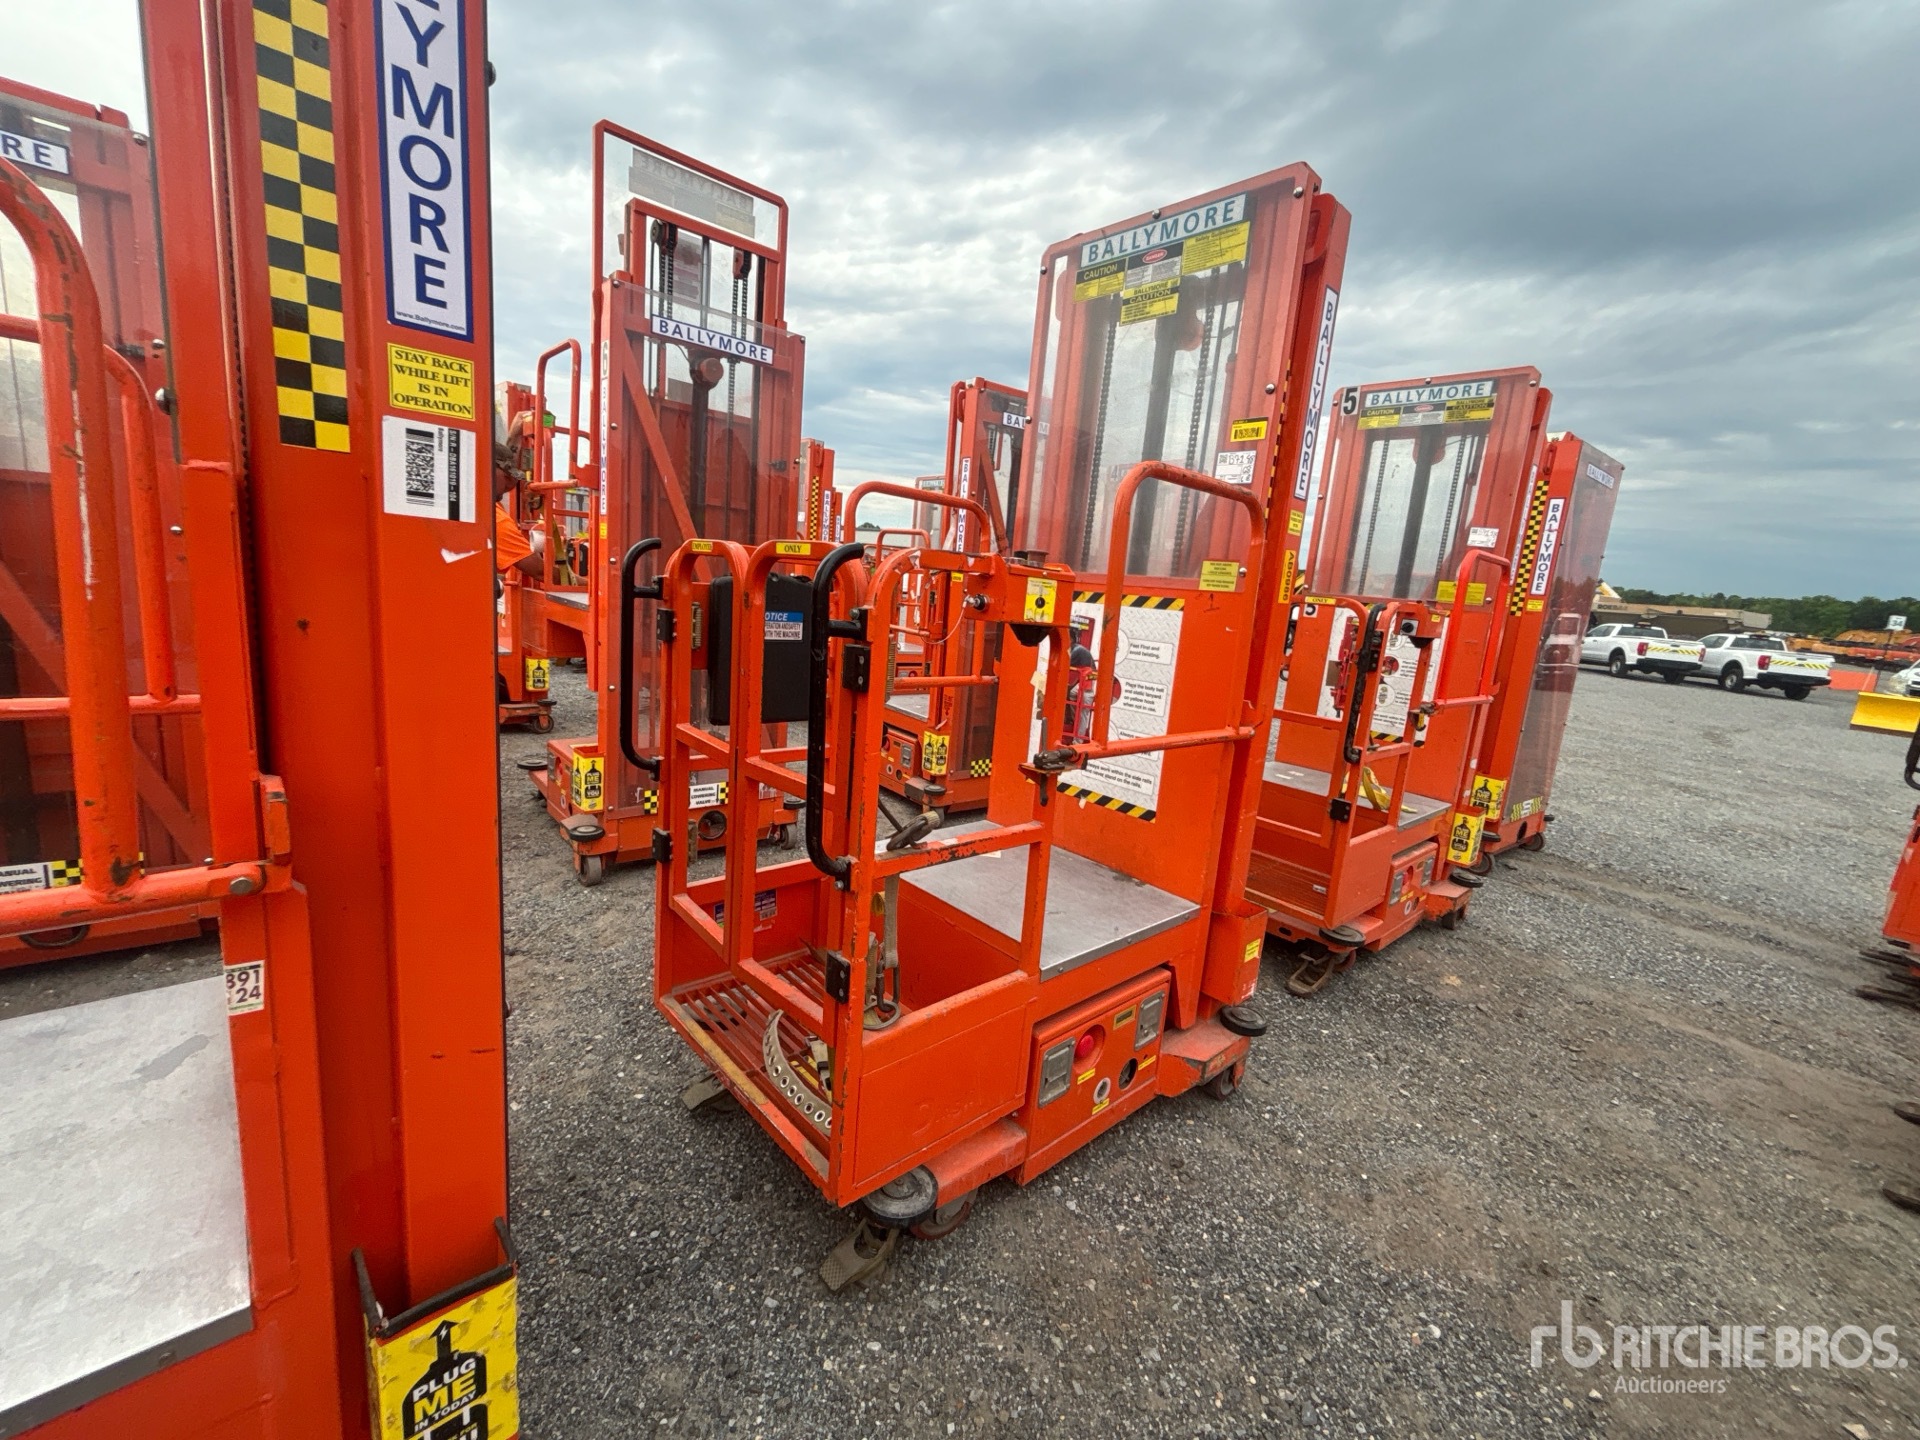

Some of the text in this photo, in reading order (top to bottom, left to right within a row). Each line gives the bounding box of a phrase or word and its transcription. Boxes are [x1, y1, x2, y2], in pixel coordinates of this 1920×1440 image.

[1088, 200, 1236, 263] BALLYMORE
[1083, 263, 1118, 281] CAUTION
[1130, 289, 1172, 304] CAUTION
[1134, 281, 1169, 296] BALLYMORE
[396, 310, 466, 332] www.Ballymore.com
[659, 319, 768, 361] BALLYMORE
[395, 349, 469, 374] STAY BACK
[393, 363, 471, 388] WHILE LIFT
[418, 382, 449, 397] IS IN
[1299, 301, 1333, 491] BALLYMORE
[1370, 383, 1486, 406] BALLYMORE
[393, 393, 472, 415] OPERATION
[1342, 387, 1358, 415] 5
[784, 544, 802, 553] ONLY
[1535, 503, 1560, 592] BALLYMORE
[765, 612, 788, 621] OTICE
[782, 630, 801, 639] MACHINE
[1145, 684, 1155, 692] body
[1087, 762, 1100, 770] ways
[1104, 772, 1117, 780] stand
[226, 969, 260, 990] 891
[235, 985, 261, 1004] 24
[412, 1358, 476, 1403] PLUG
[414, 1369, 476, 1424] ME
[414, 1390, 477, 1433] IN TODAY
